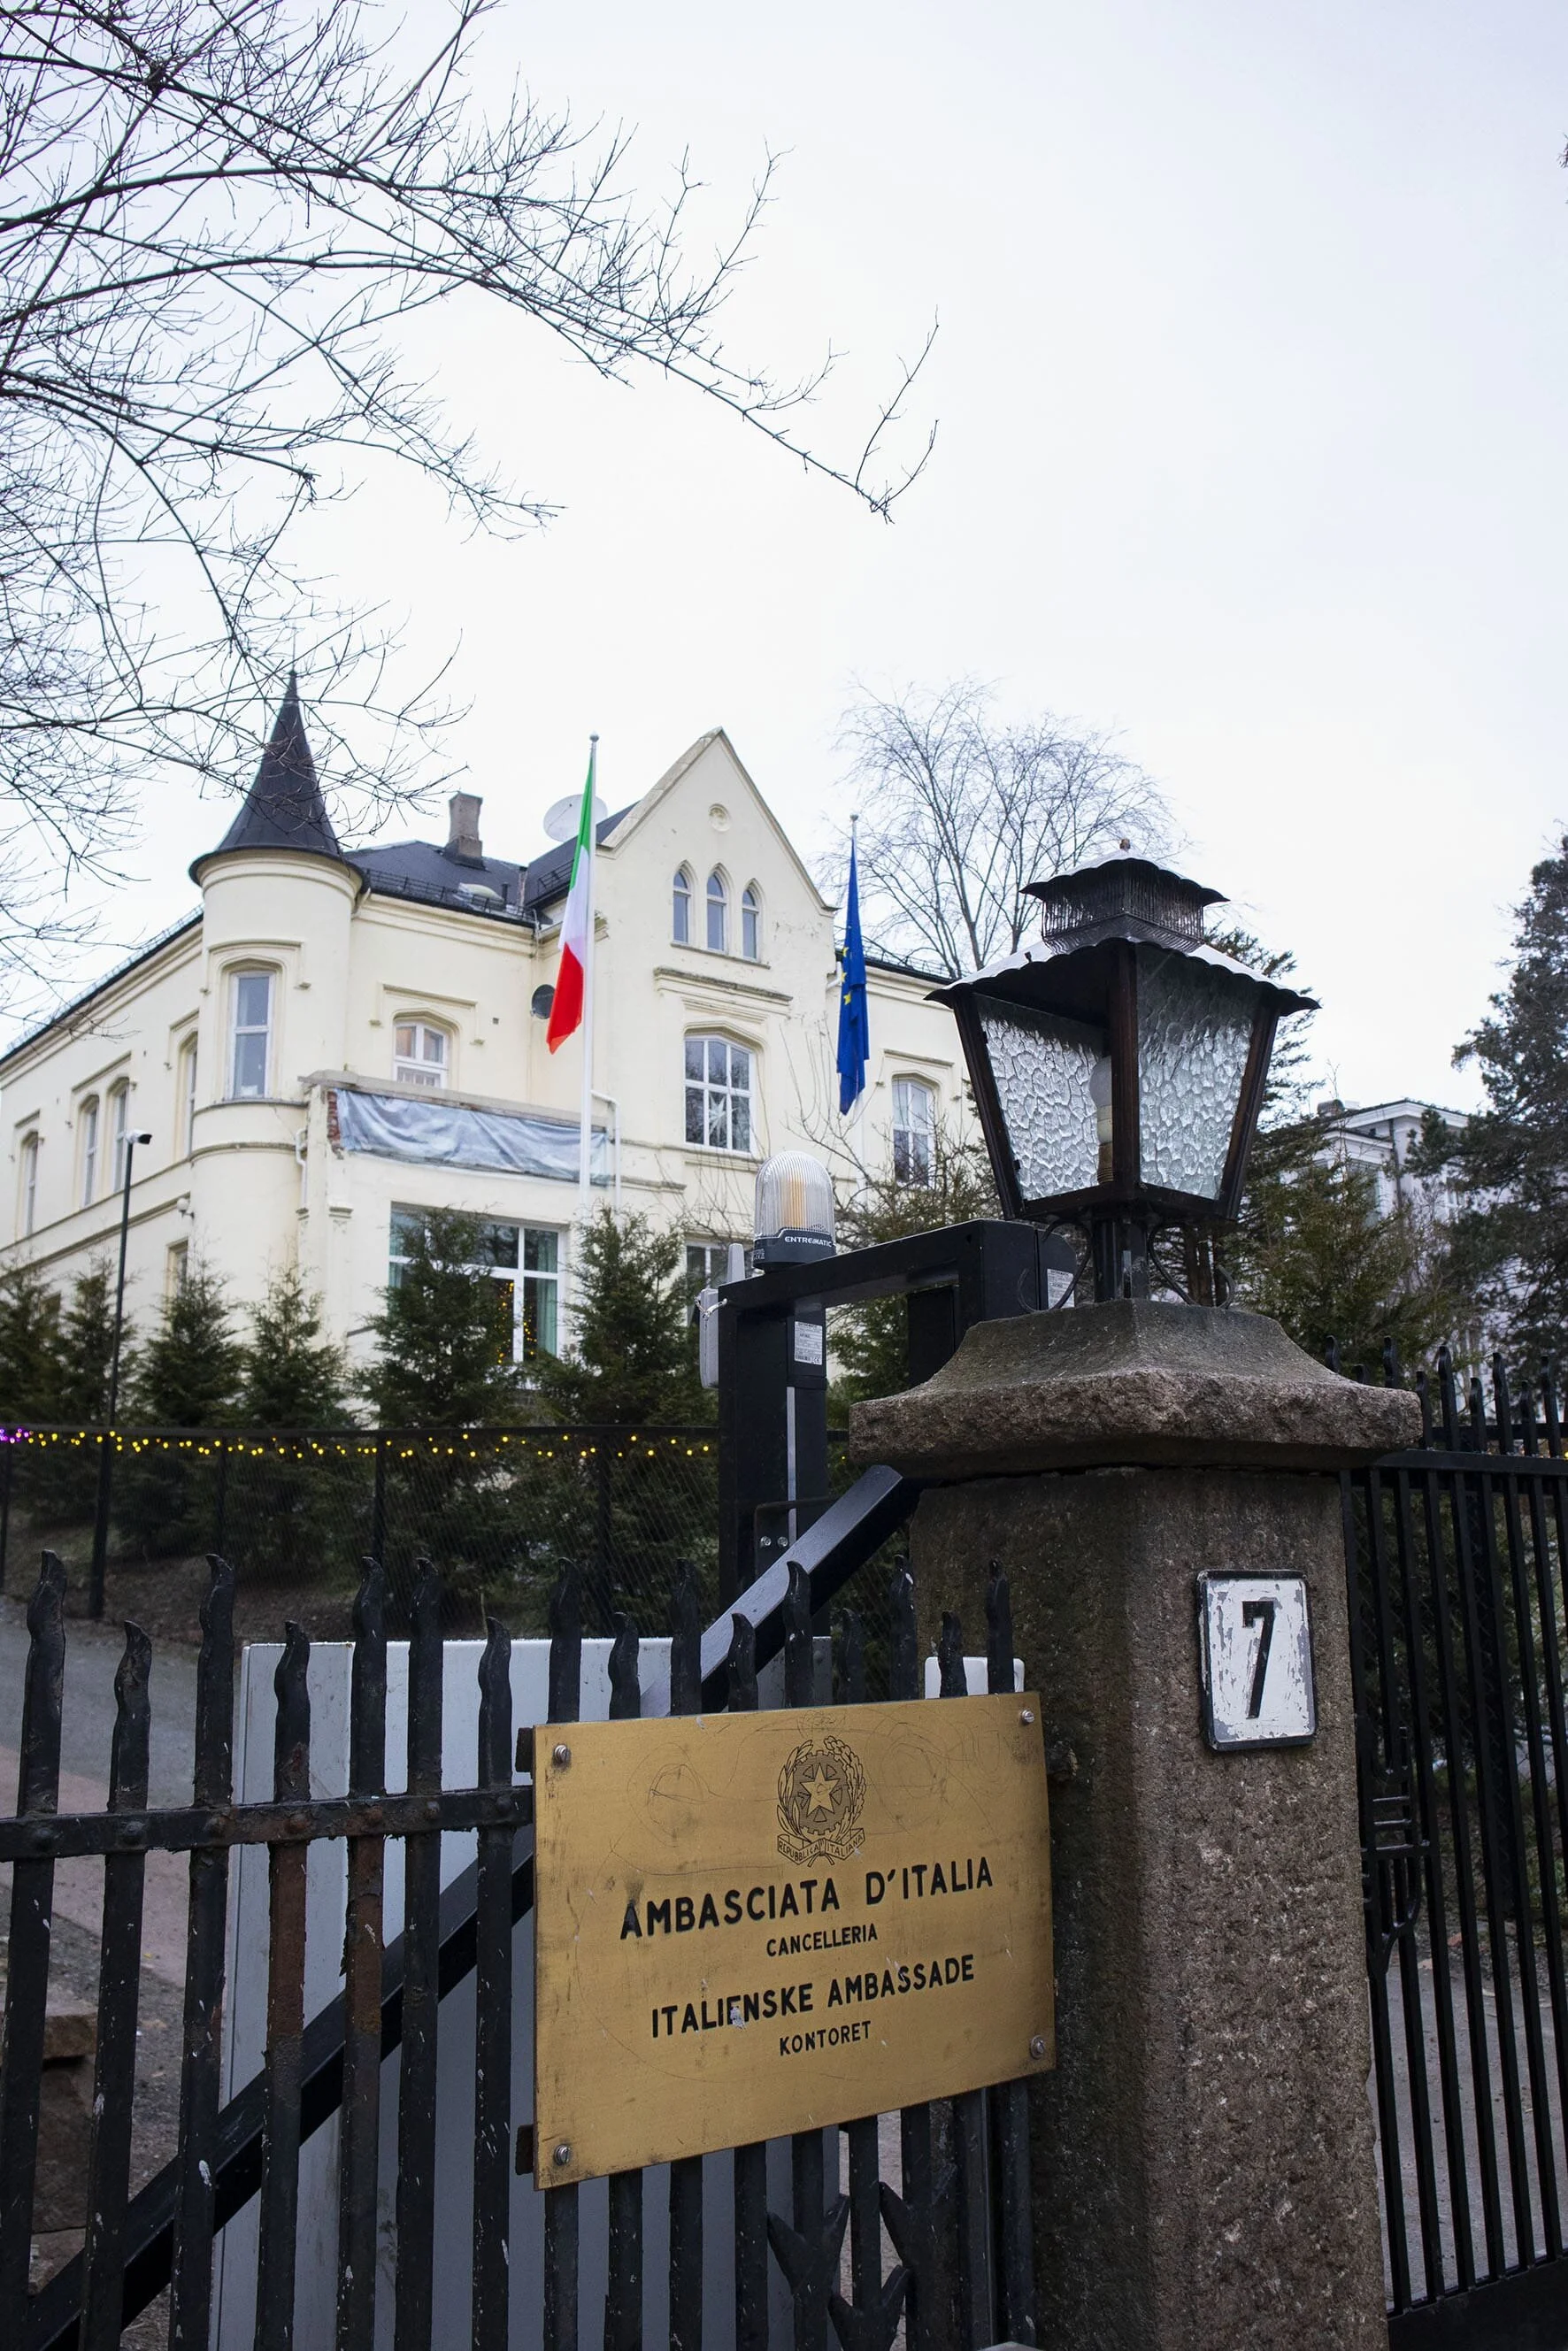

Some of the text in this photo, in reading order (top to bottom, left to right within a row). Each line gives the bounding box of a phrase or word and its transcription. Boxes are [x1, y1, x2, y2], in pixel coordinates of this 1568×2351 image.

[785, 1236, 832, 1247] ENTREMATIC
[1241, 1600, 1275, 1719] 7
[779, 1834, 863, 1861] REPUBBLICA ITALIANA
[620, 1856, 992, 1940] AMBASCIATA D'ITALIA
[766, 1923, 878, 1956] CANCELLERIA
[652, 1954, 974, 2038] ITALIENSKE AMBASSADE
[780, 2021, 871, 2056] KONTORET
